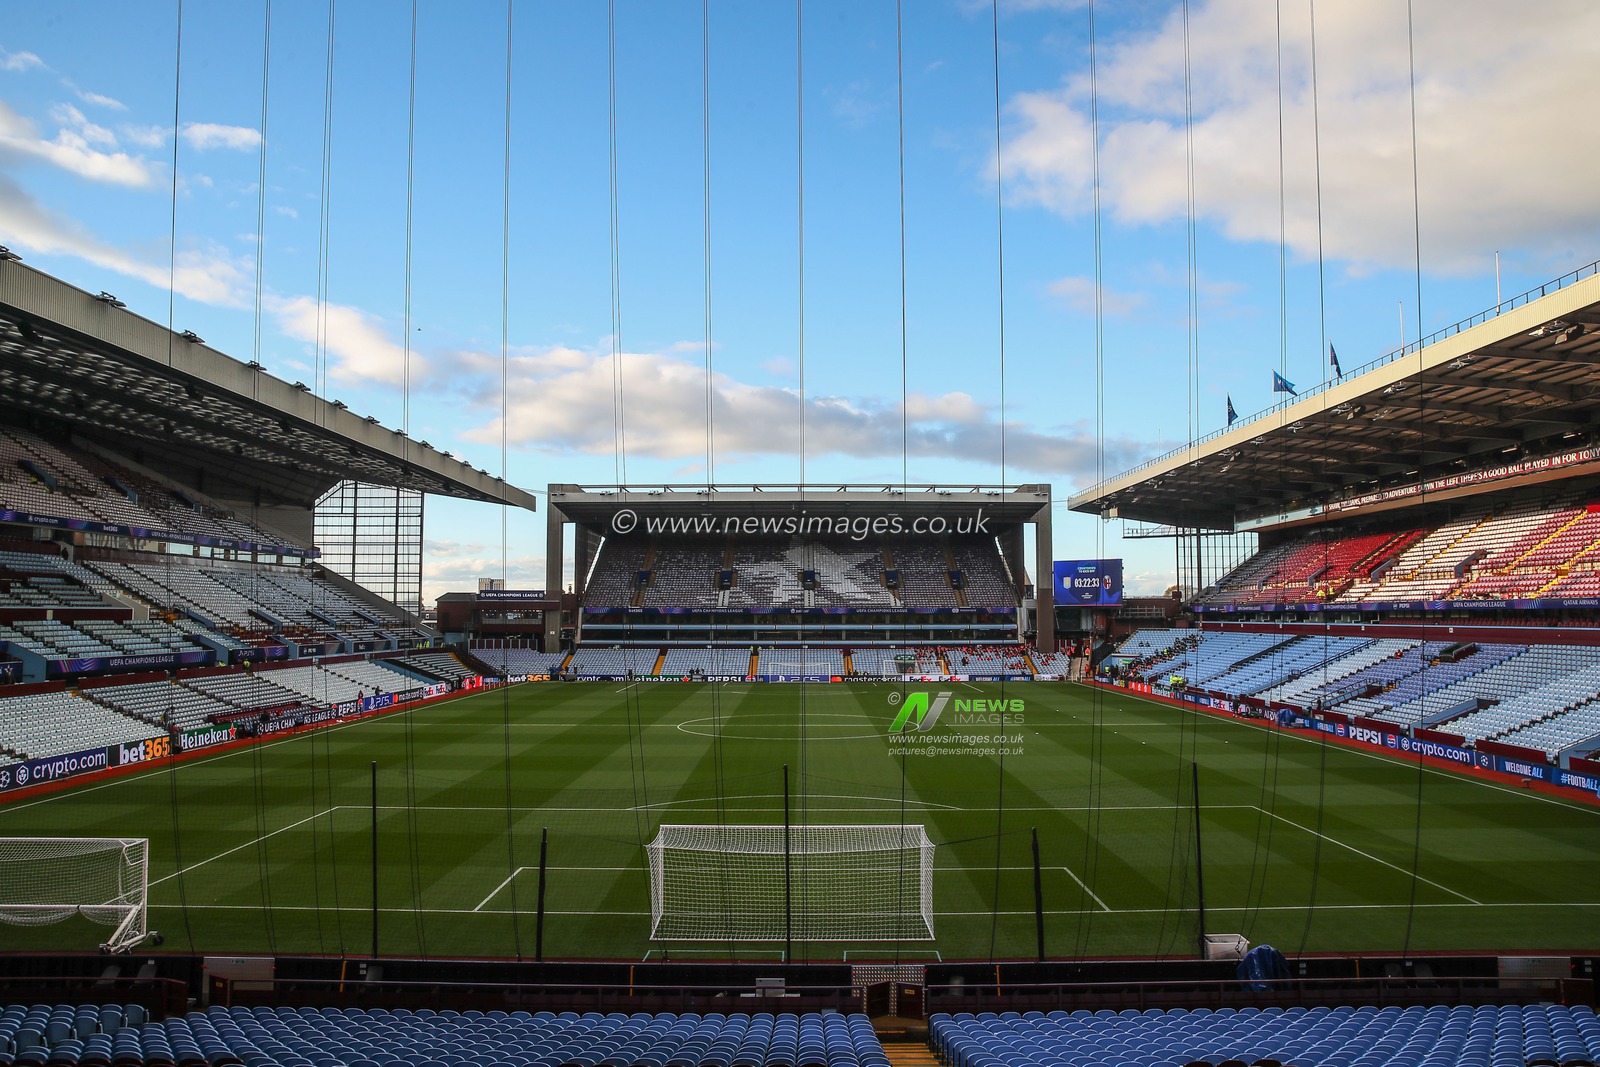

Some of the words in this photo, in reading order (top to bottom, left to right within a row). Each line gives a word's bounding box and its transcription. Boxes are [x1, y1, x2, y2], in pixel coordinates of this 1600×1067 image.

[1389, 486, 1416, 498] ADVENTURE
[1434, 480, 1445, 488] THE
[1488, 467, 1507, 478] GOOD
[1508, 463, 1523, 474] BALL
[1524, 459, 1549, 471] PLAYED
[1552, 456, 1561, 465] IN
[1562, 453, 1577, 464] FOR
[1579, 448, 1600, 459] TONY
[34, 516, 58, 525] crypto.com
[1075, 577, 1100, 588] 03:22:33
[110, 658, 124, 666] UEFA
[125, 656, 155, 665] CHAMPIONS
[156, 655, 174, 663] LEAGUE
[265, 722, 281, 733] UEFA
[312, 711, 330, 723] LEAGUE
[180, 729, 228, 750] Heineken
[1349, 726, 1382, 745] PEPSI
[119, 736, 171, 765] bet365
[1412, 741, 1470, 763] crypto.com
[33, 752, 106, 779] crypto.com
[1505, 760, 1532, 776] WELCOME
[1531, 766, 1543, 779] ALL
[1560, 773, 1598, 791] #FOOTBALL
